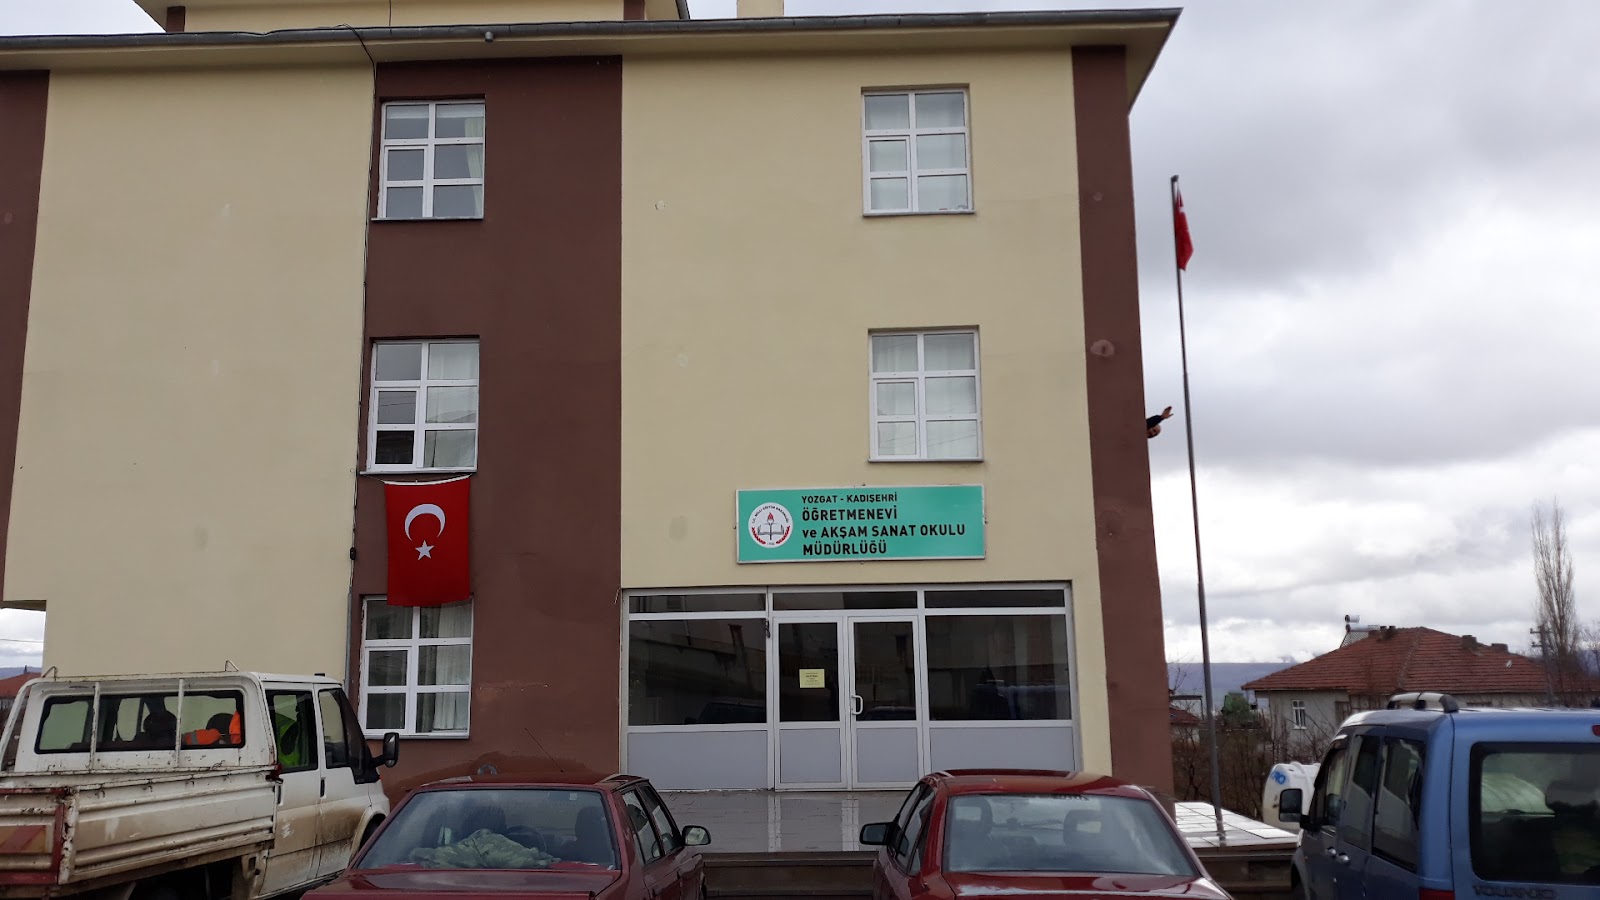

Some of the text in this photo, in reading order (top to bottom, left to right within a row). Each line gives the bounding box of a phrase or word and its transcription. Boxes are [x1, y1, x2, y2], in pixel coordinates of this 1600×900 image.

[801, 495, 838, 504] YOZGAT
[846, 491, 898, 504] KADIŞEHRİ
[801, 504, 898, 522] ÖĞRETMENEVİ
[802, 523, 965, 540] ve AKŞAM SANAT OKULU
[803, 538, 887, 556] MÜDÜRLÜĞÜ
